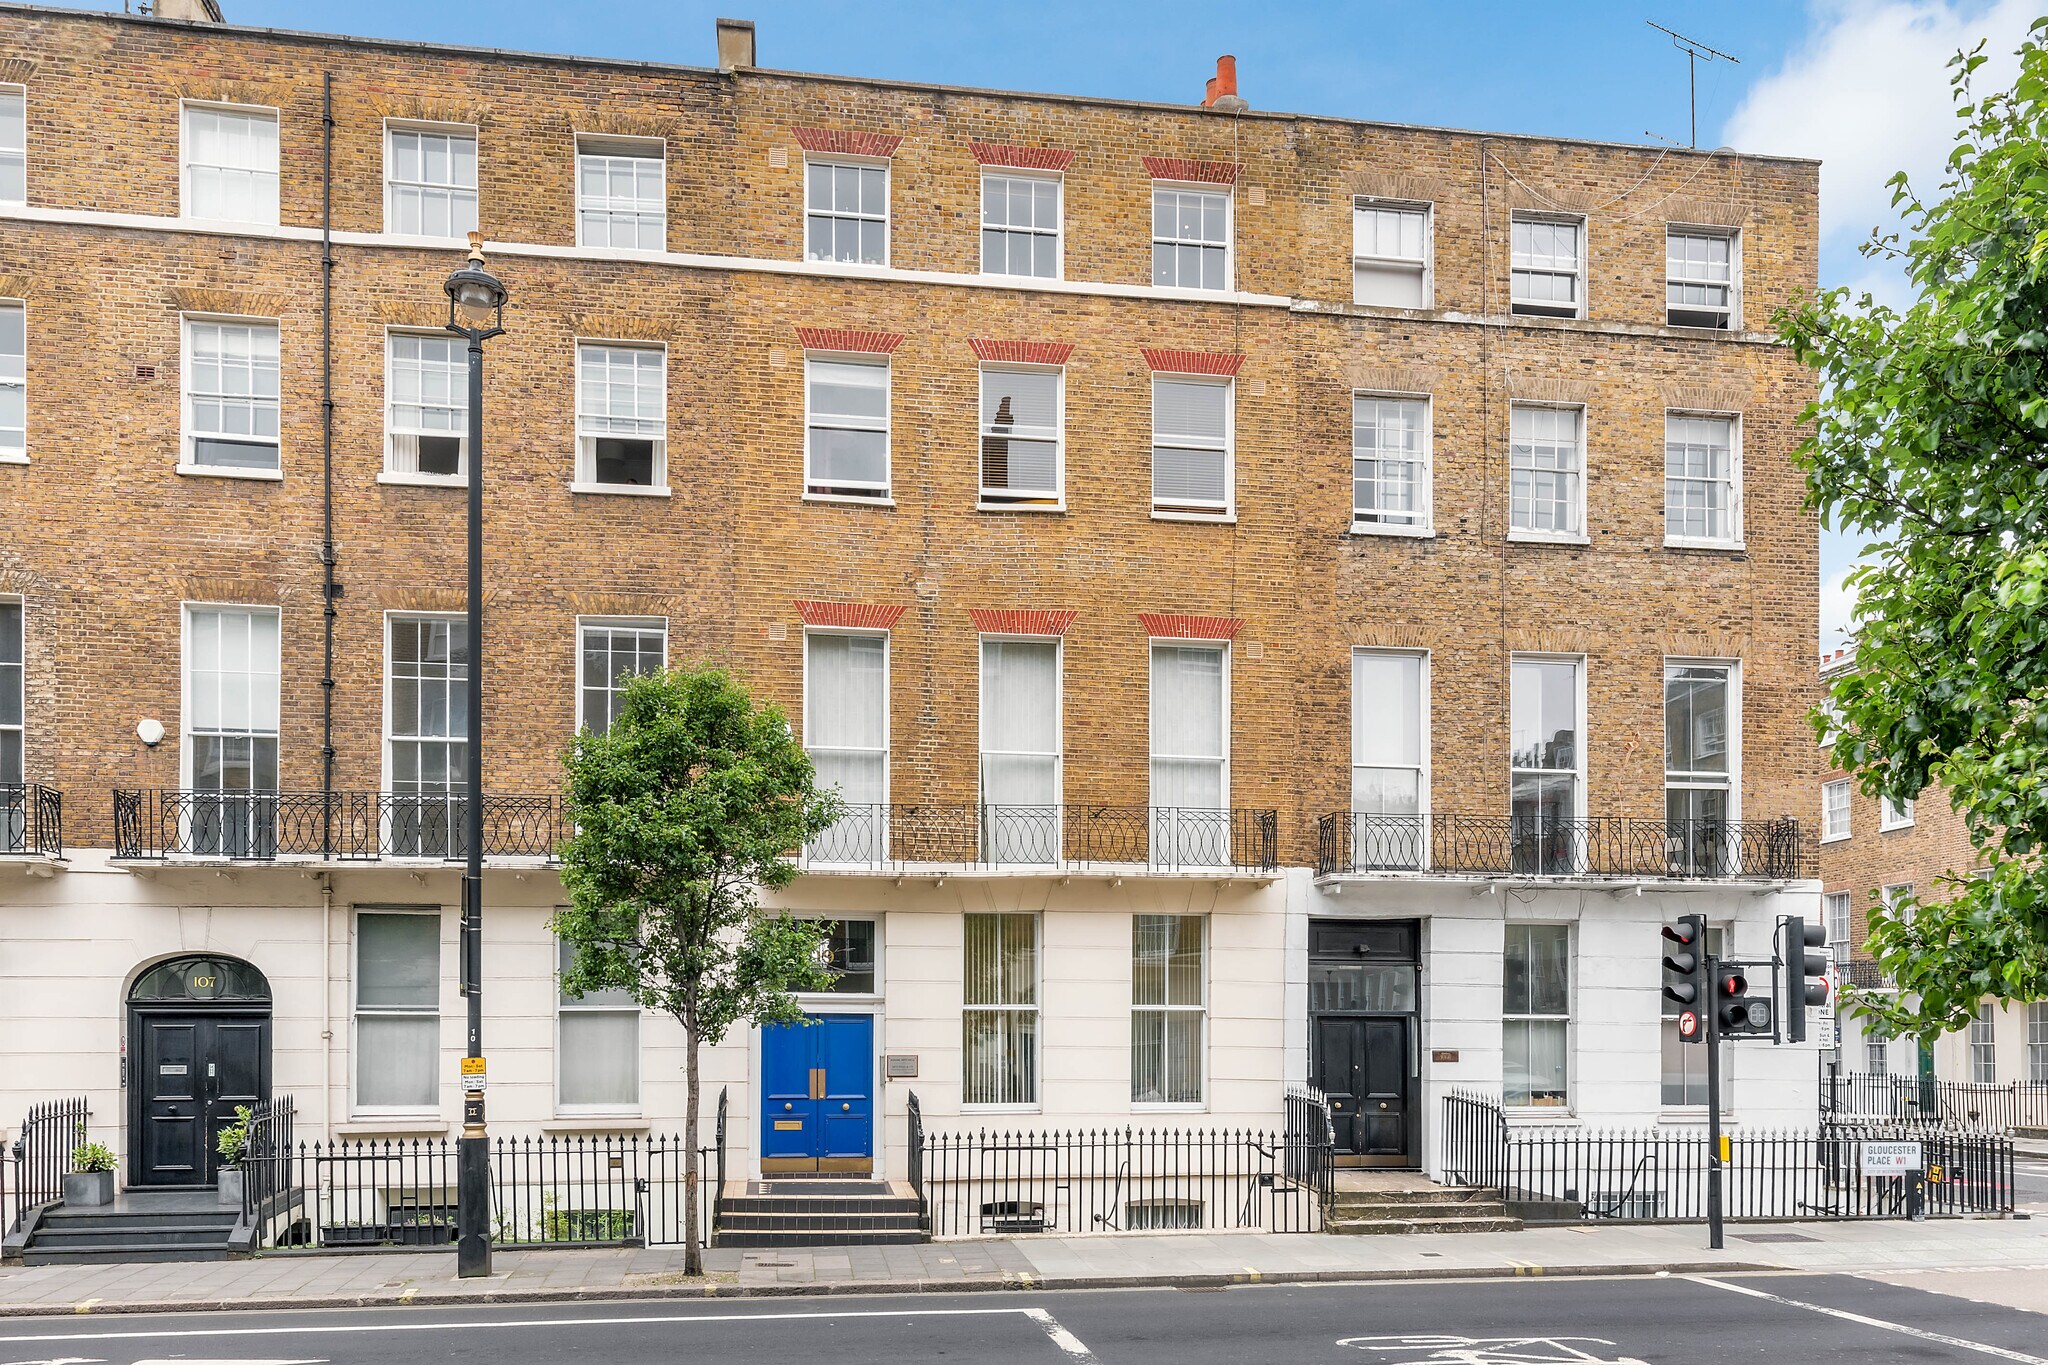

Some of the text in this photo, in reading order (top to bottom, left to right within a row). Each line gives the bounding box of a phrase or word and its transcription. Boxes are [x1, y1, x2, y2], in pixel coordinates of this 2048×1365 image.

[193, 976, 216, 988] 107
[1867, 1146, 1917, 1155] GLOUCESTER
[1867, 1156, 1906, 1165] PLACE W1
